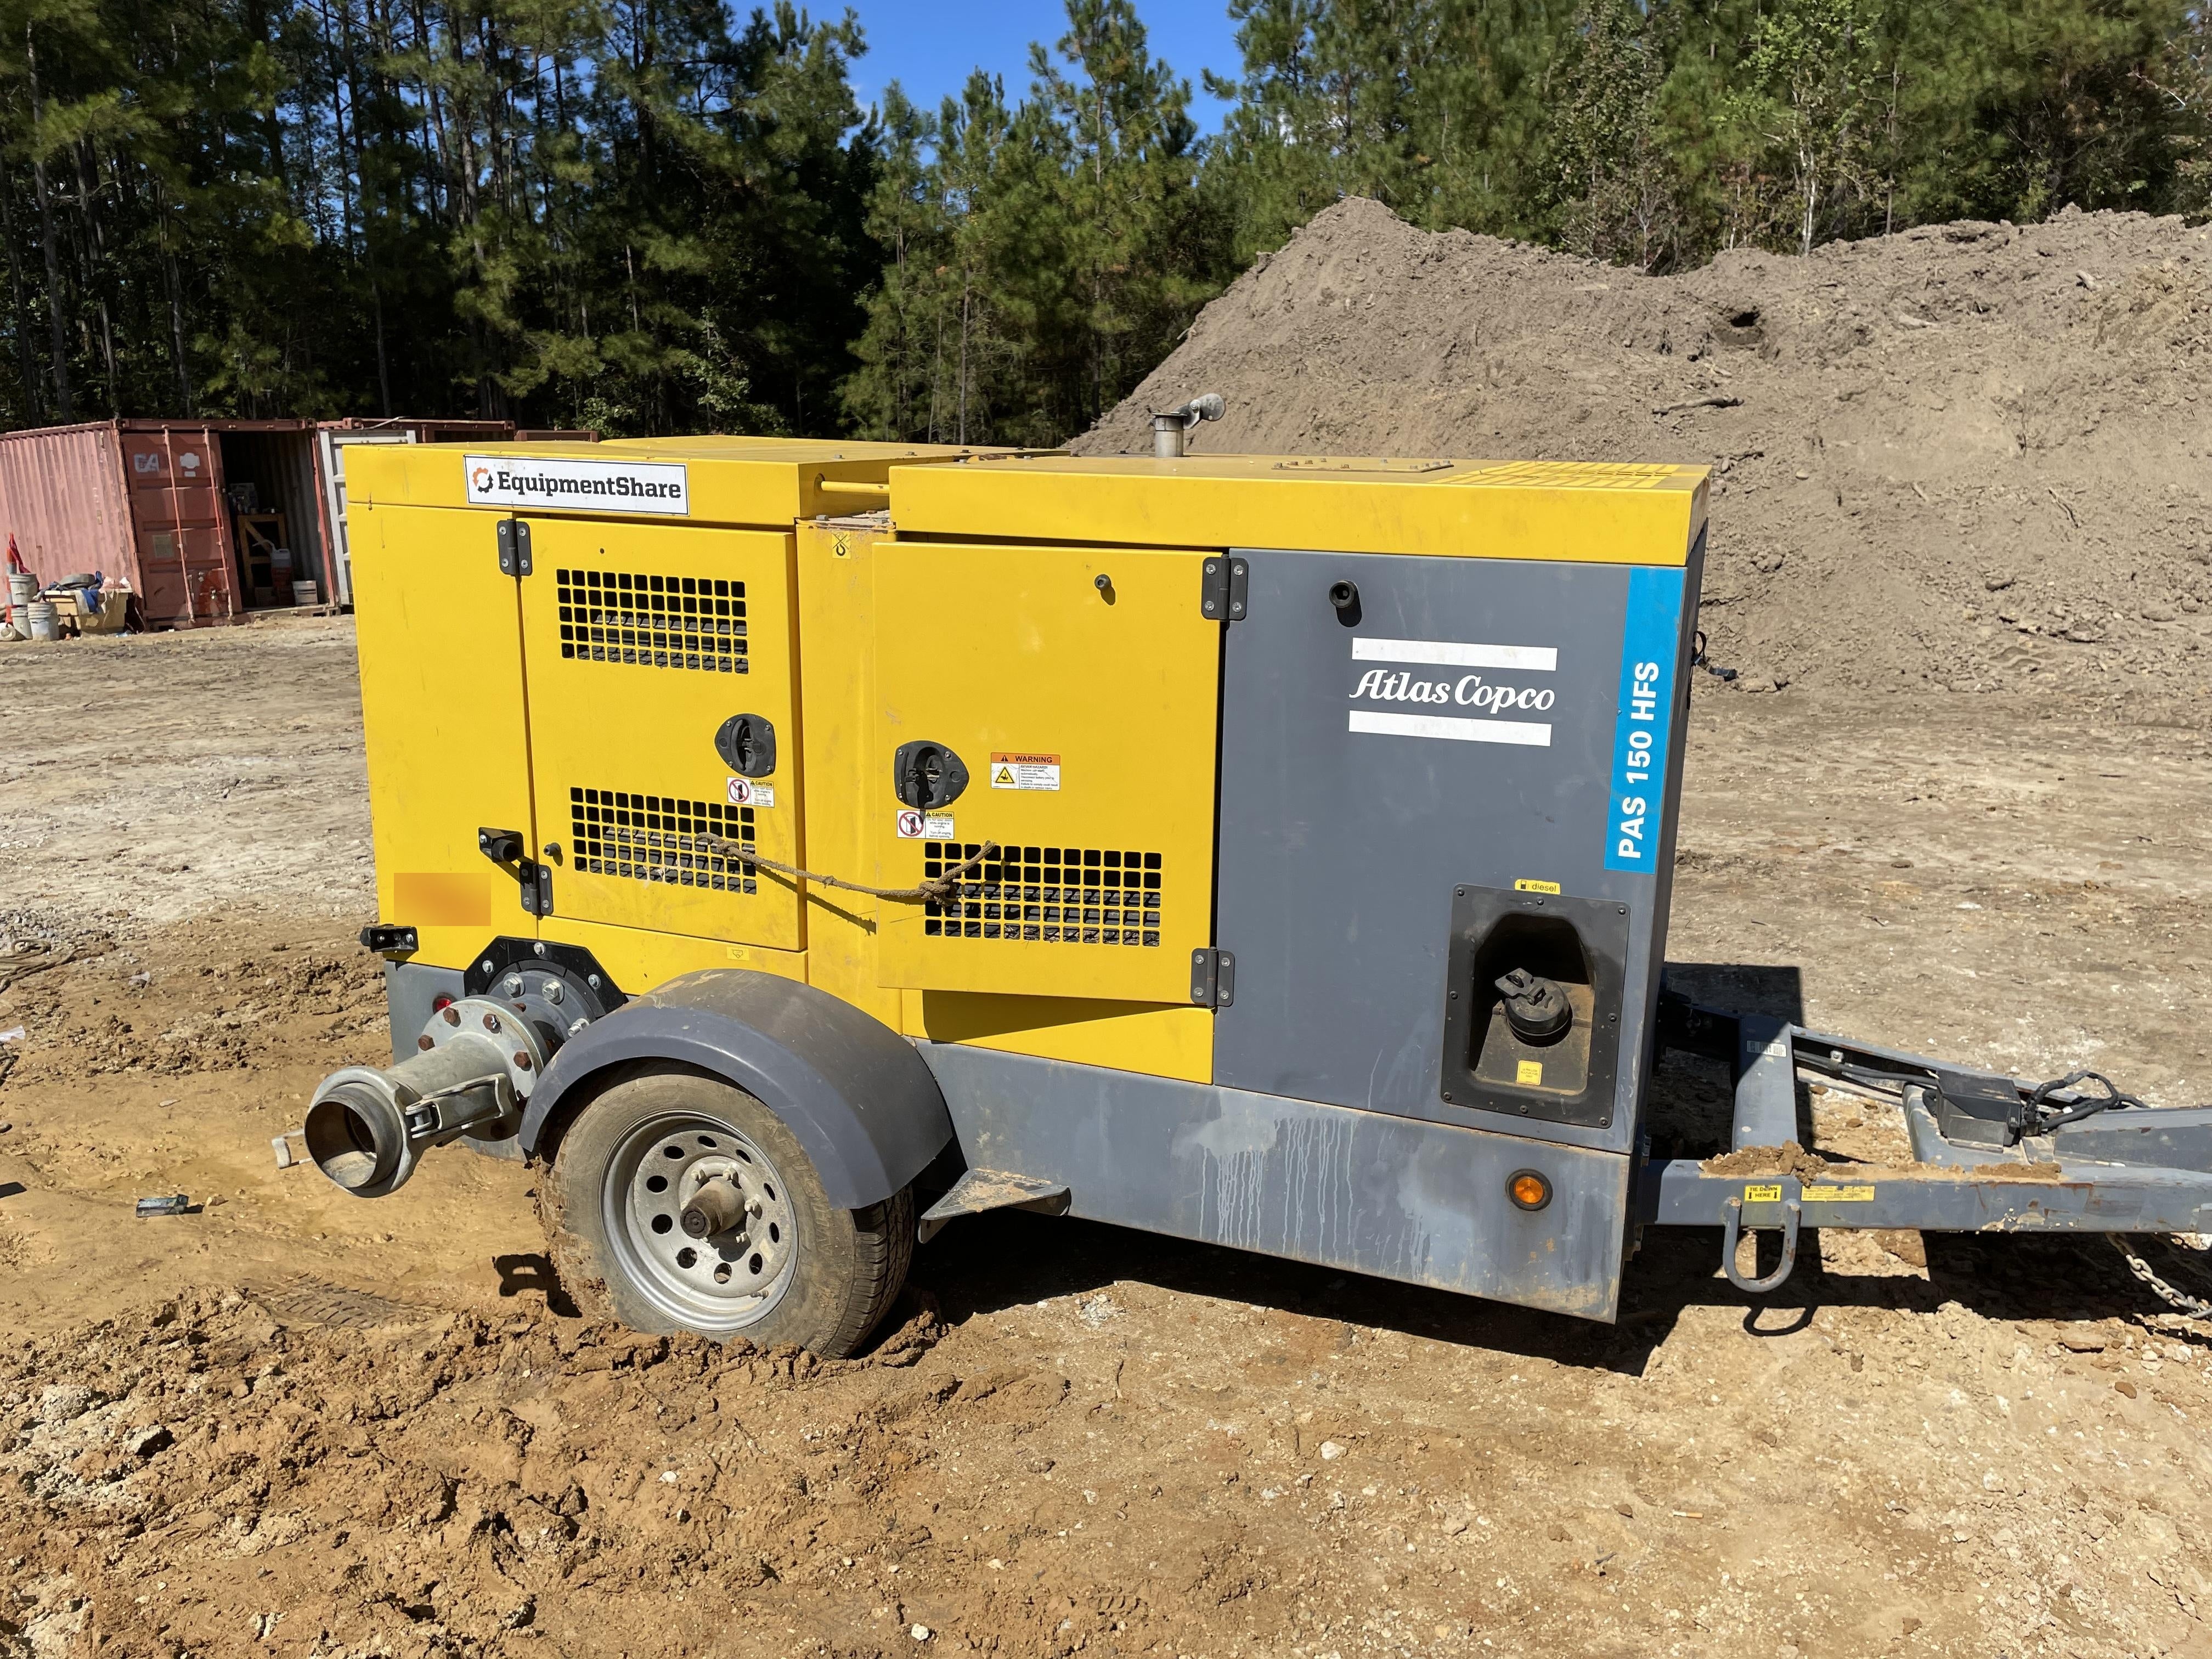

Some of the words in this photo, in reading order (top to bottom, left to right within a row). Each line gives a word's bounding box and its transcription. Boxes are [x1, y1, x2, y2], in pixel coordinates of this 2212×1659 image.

[496, 471, 681, 498] EquipmentShare
[1348, 669, 1451, 704] Atlas
[1454, 675, 1555, 714] Copco
[1630, 662, 1660, 721] HFS
[1015, 755, 1053, 763] WARNING
[1626, 731, 1652, 784] 150
[1618, 797, 1646, 859] PAS
[1532, 883, 1556, 892] diesel
